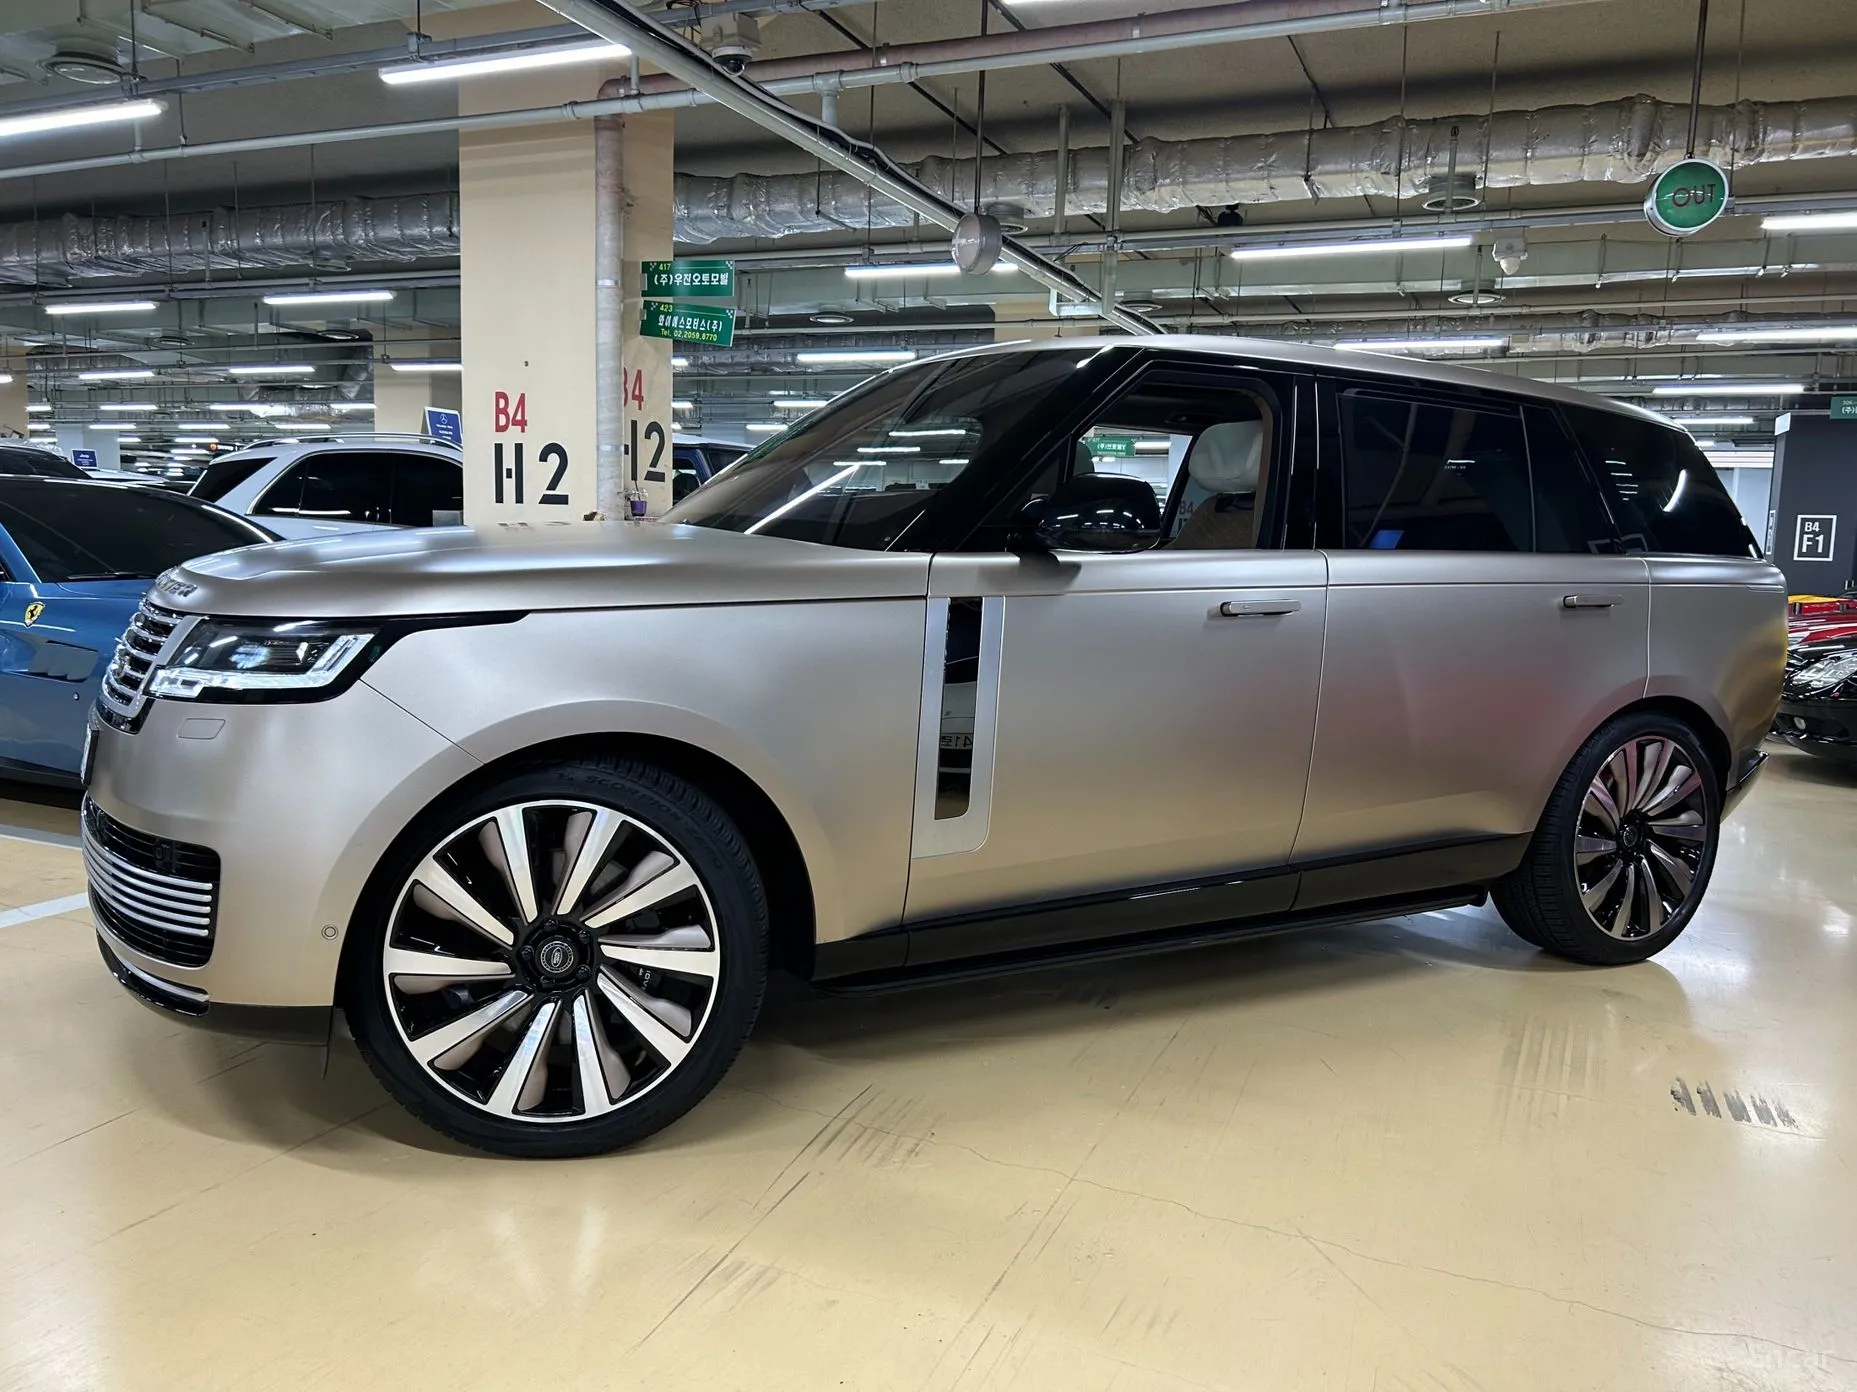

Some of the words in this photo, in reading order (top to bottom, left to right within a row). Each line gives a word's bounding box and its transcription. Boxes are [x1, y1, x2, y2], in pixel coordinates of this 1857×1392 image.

[1672, 183, 1716, 207] OUT
[659, 263, 671, 271] 417
[654, 272, 729, 286] (주)우진오토모빌
[660, 304, 673, 312] 423
[658, 314, 723, 333] 와이에스모터스(주)
[495, 391, 528, 433] B4
[1804, 521, 1821, 532] B4
[1802, 534, 1825, 553] F1
